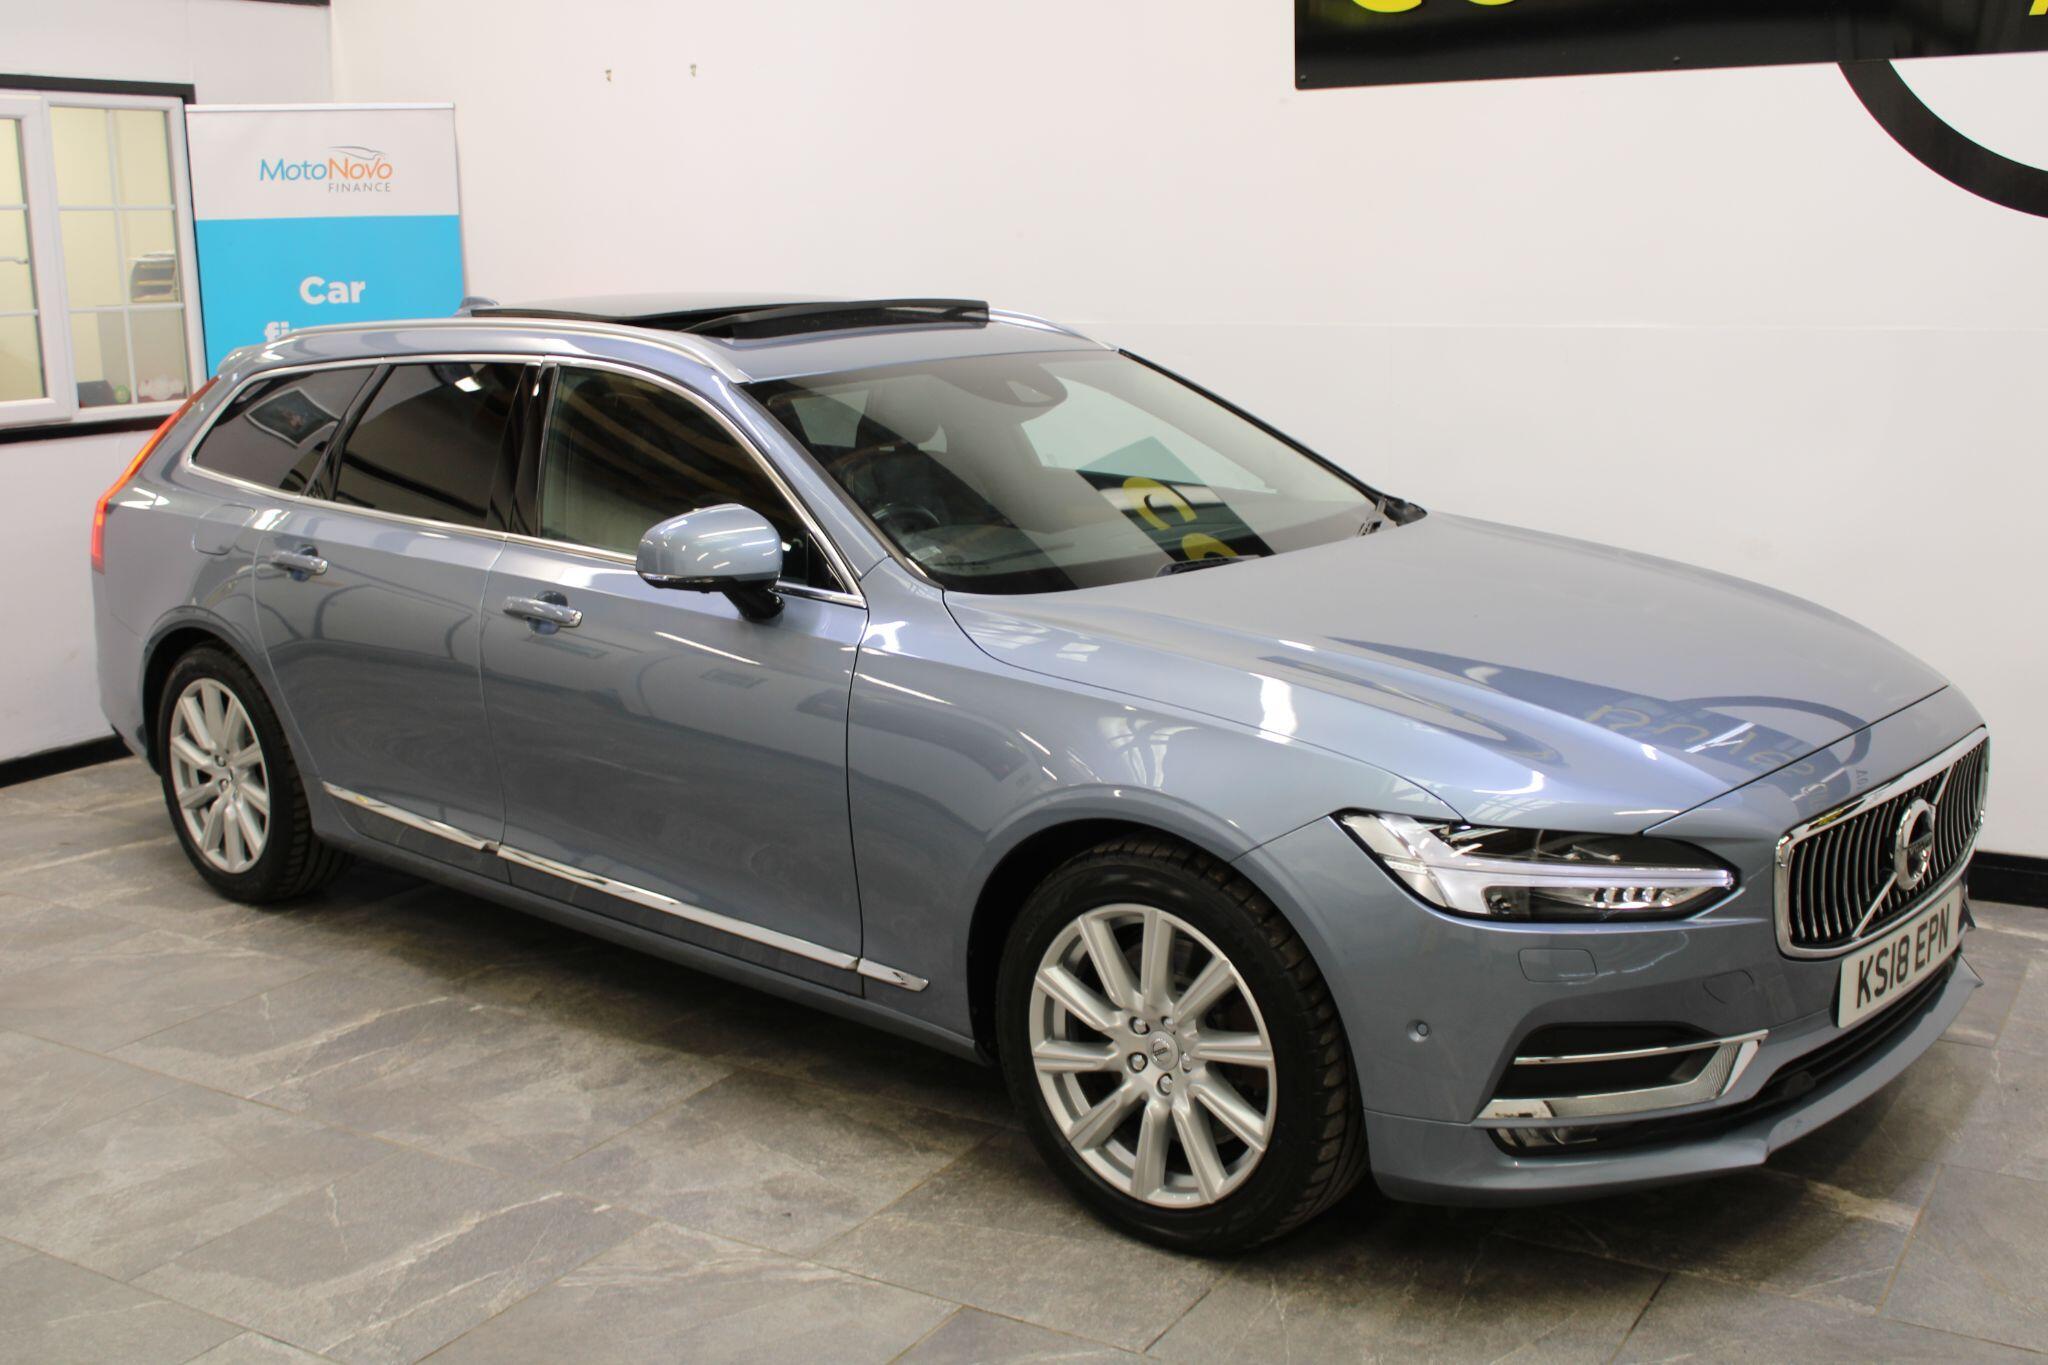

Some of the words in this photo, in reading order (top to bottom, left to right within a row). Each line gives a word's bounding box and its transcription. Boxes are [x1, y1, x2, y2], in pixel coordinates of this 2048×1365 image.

[259, 158, 393, 181] MotoNovo
[328, 182, 392, 192] FINANCE
[300, 276, 366, 305] Car
[1856, 934, 1910, 1009] KS18
[1914, 903, 1950, 972] EPN
